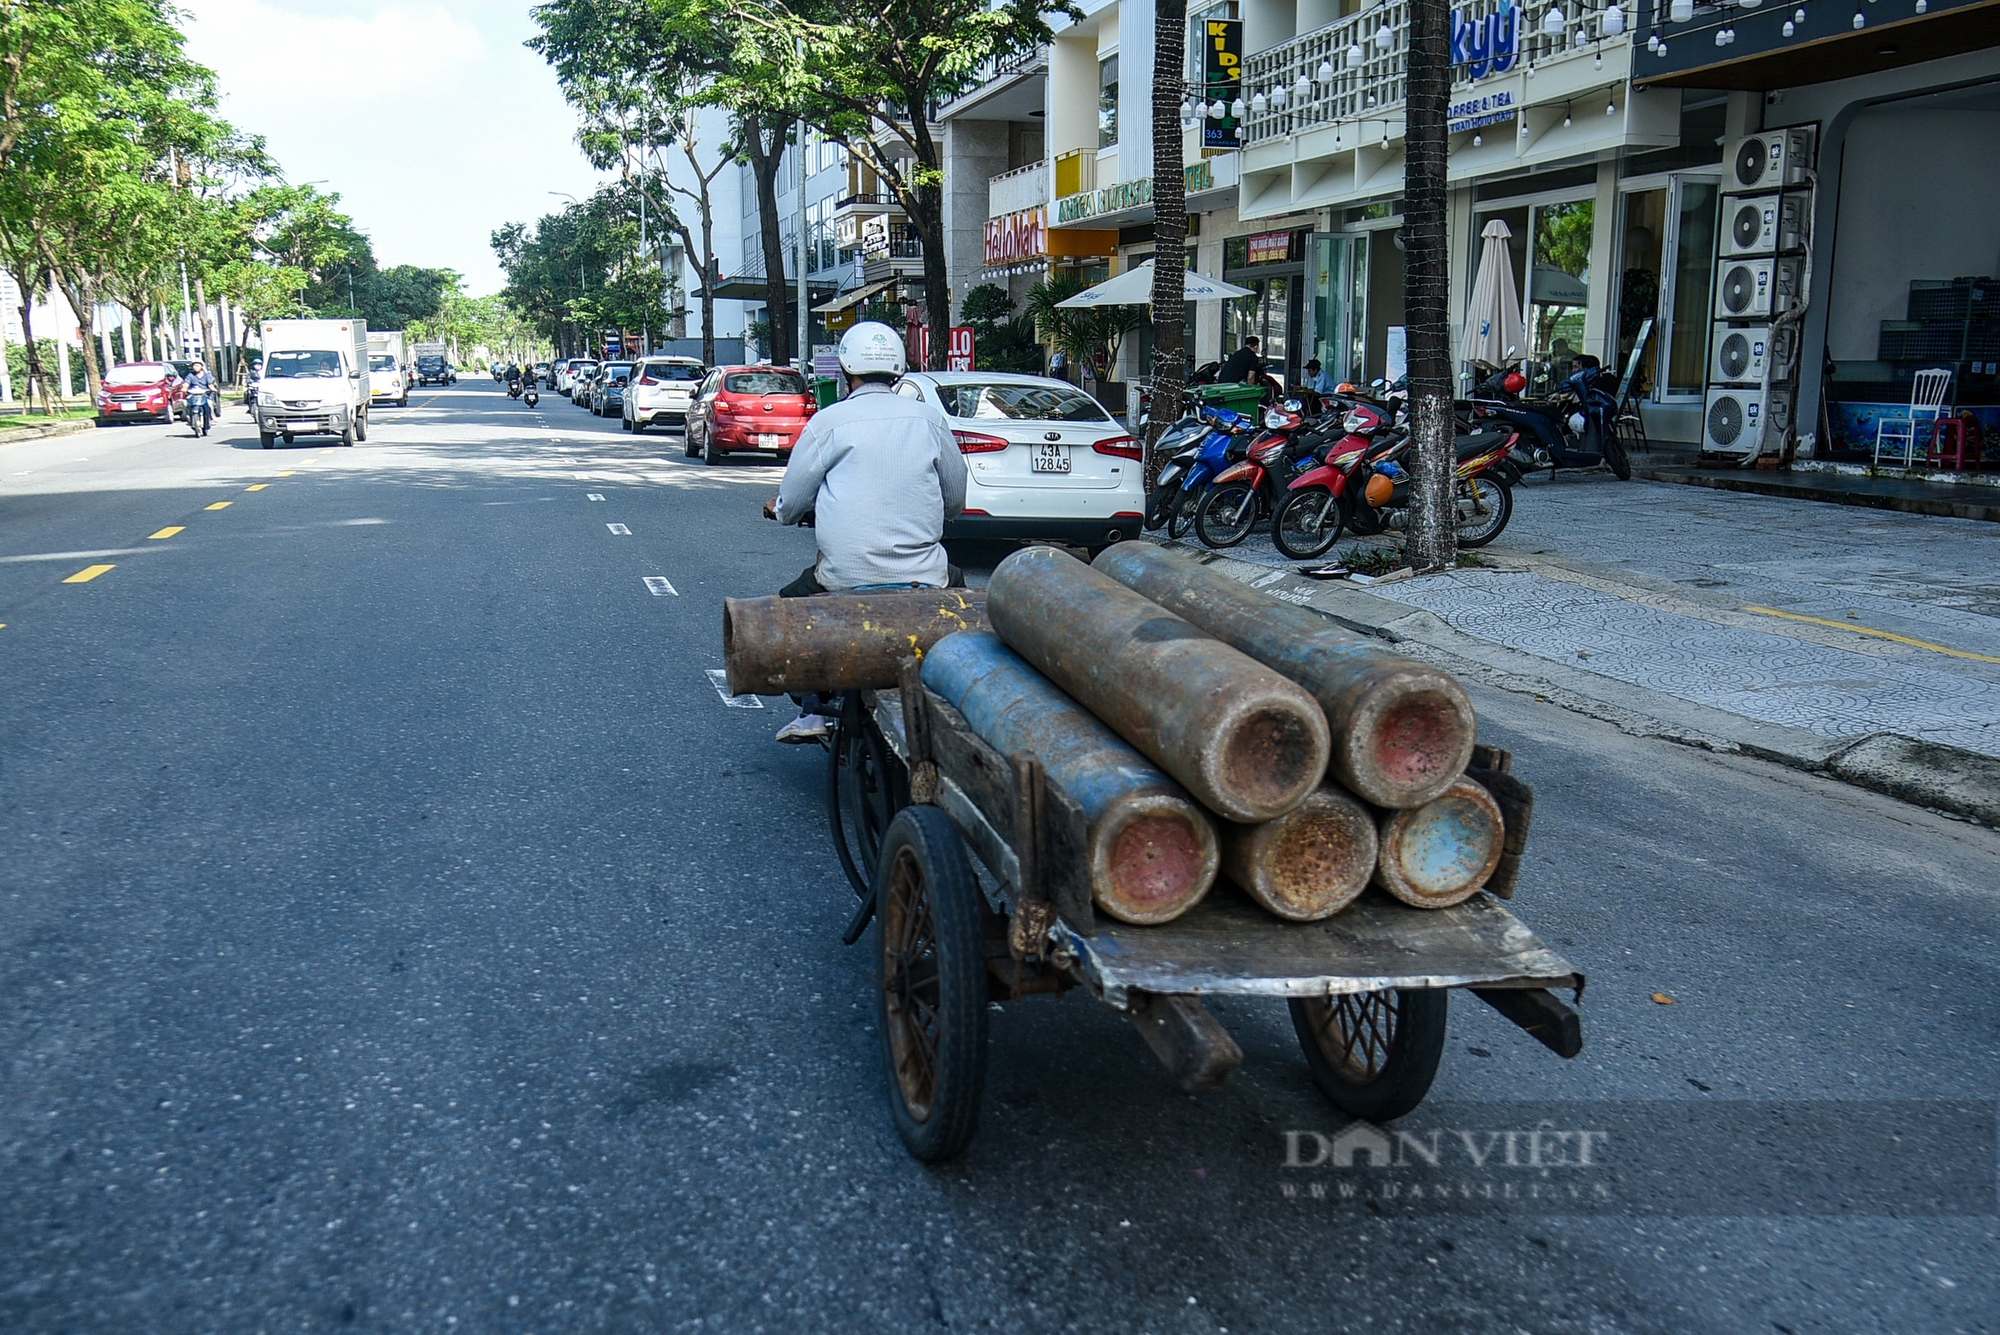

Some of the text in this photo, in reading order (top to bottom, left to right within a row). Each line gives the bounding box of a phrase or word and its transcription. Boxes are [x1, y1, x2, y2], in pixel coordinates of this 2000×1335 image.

[1208, 22, 1241, 80] KIDS
[1208, 72, 1239, 129] ZOE
[1447, 91, 1513, 118] OFFEE & TEA
[1206, 130, 1223, 139] 363
[1097, 178, 1152, 213] RIVERSID
[1184, 160, 1213, 191] TEL
[1035, 458, 1070, 471] 128.45
[1041, 445, 1061, 457] 43A
